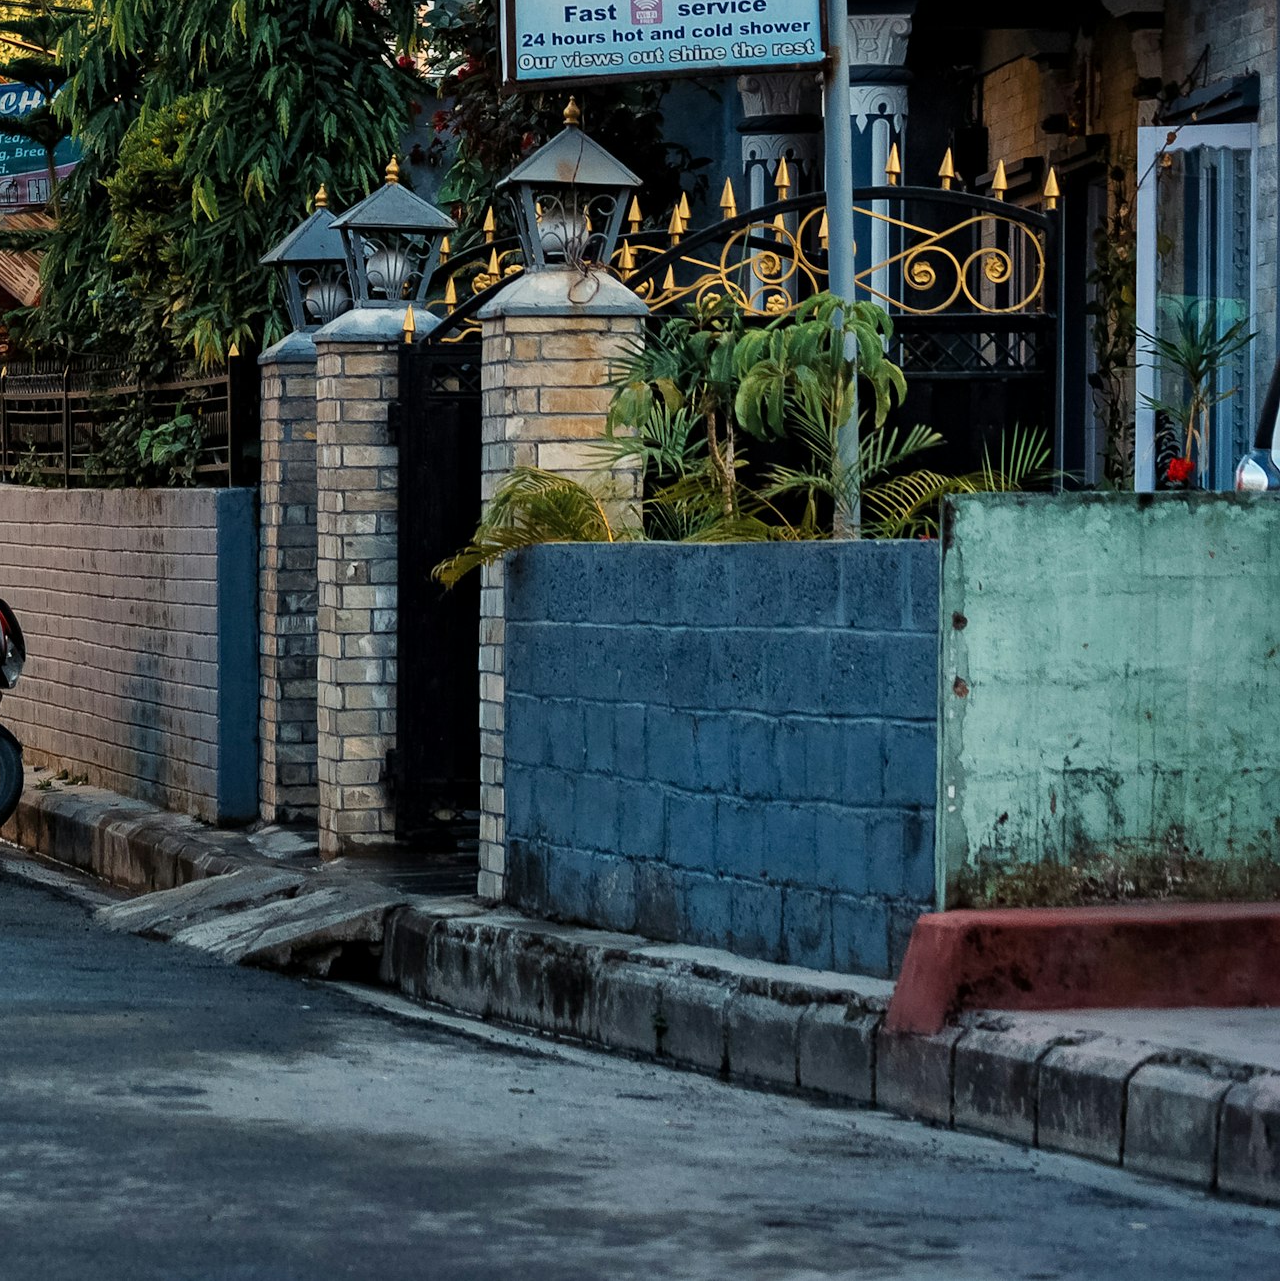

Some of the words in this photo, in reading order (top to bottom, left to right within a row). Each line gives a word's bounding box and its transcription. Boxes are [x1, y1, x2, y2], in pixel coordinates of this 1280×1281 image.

[563, 2, 618, 23] Fast
[521, 32, 546, 48] 24
[551, 28, 606, 46] hours
[612, 27, 645, 43] hot
[650, 25, 686, 41] and
[691, 22, 734, 38] cold
[739, 20, 811, 37] shower
[519, 54, 558, 71] Our
[561, 49, 624, 68] views
[629, 48, 664, 64] out
[669, 43, 727, 62] shine
[731, 41, 768, 59] the
[771, 38, 817, 57] rest
[14, 144, 58, 159] Brea,
